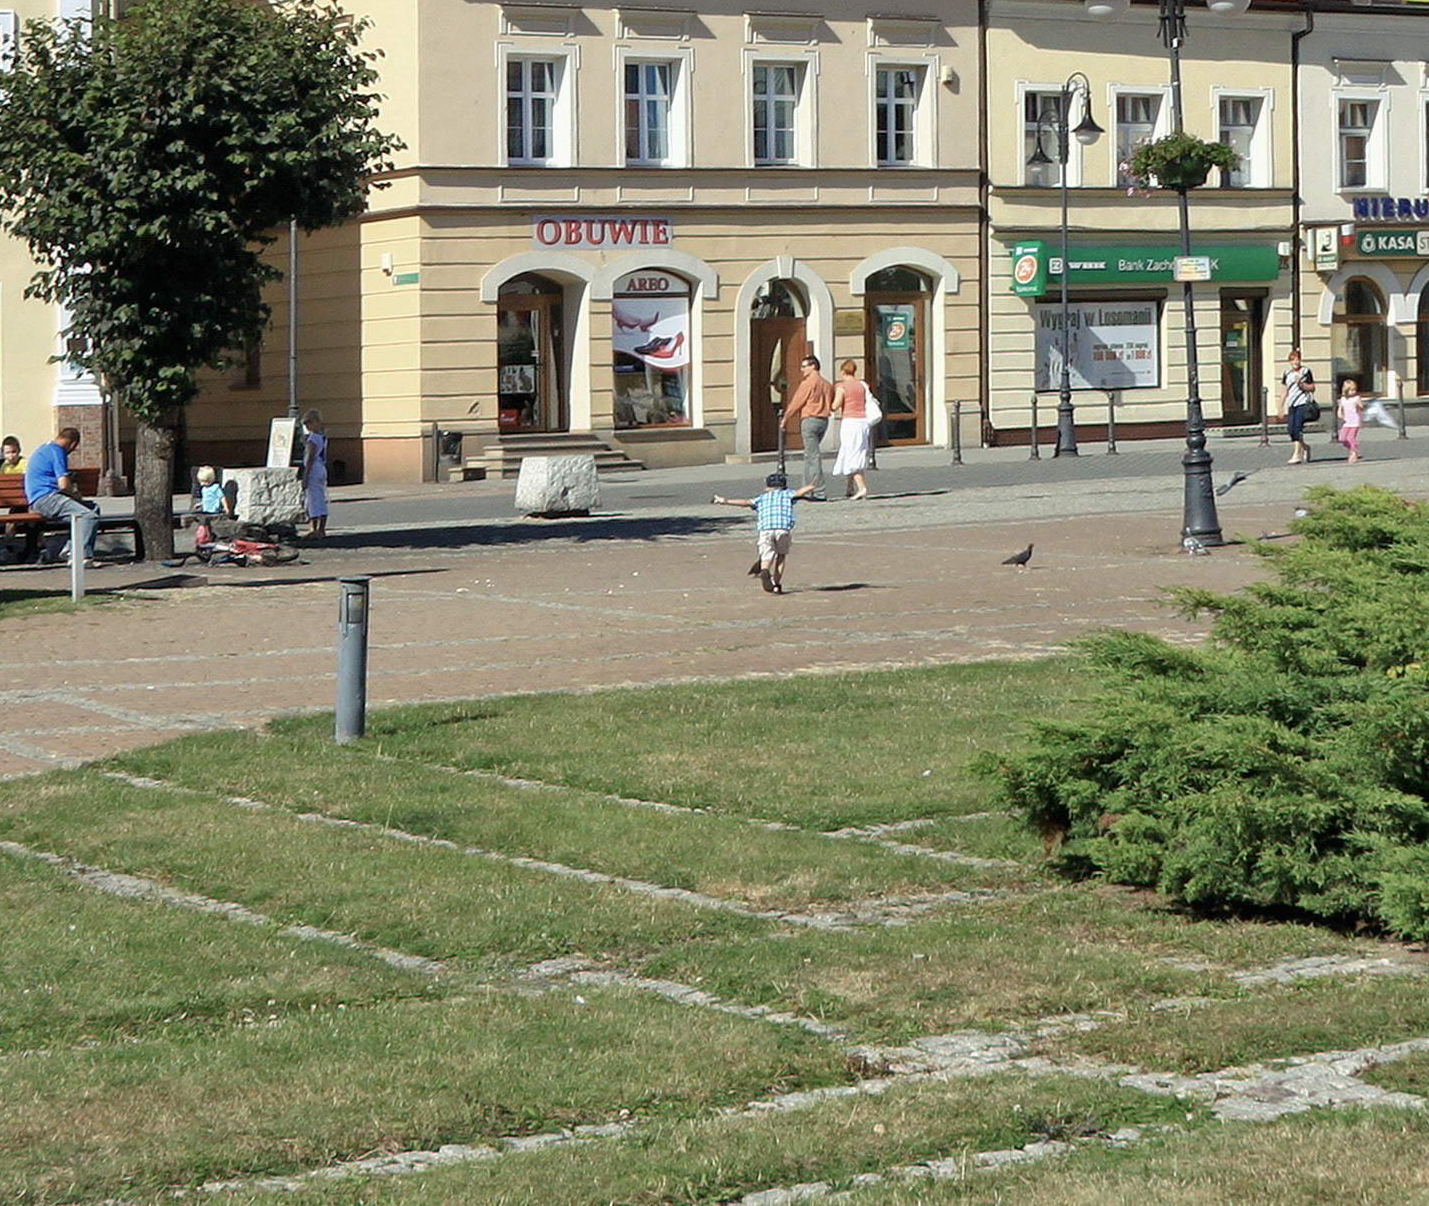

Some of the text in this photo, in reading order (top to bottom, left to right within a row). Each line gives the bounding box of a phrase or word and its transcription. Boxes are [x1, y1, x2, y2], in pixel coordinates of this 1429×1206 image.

[536, 218, 669, 245] OBUWIE
[1378, 236, 1415, 250] KASA
[1118, 258, 1144, 271] Bank
